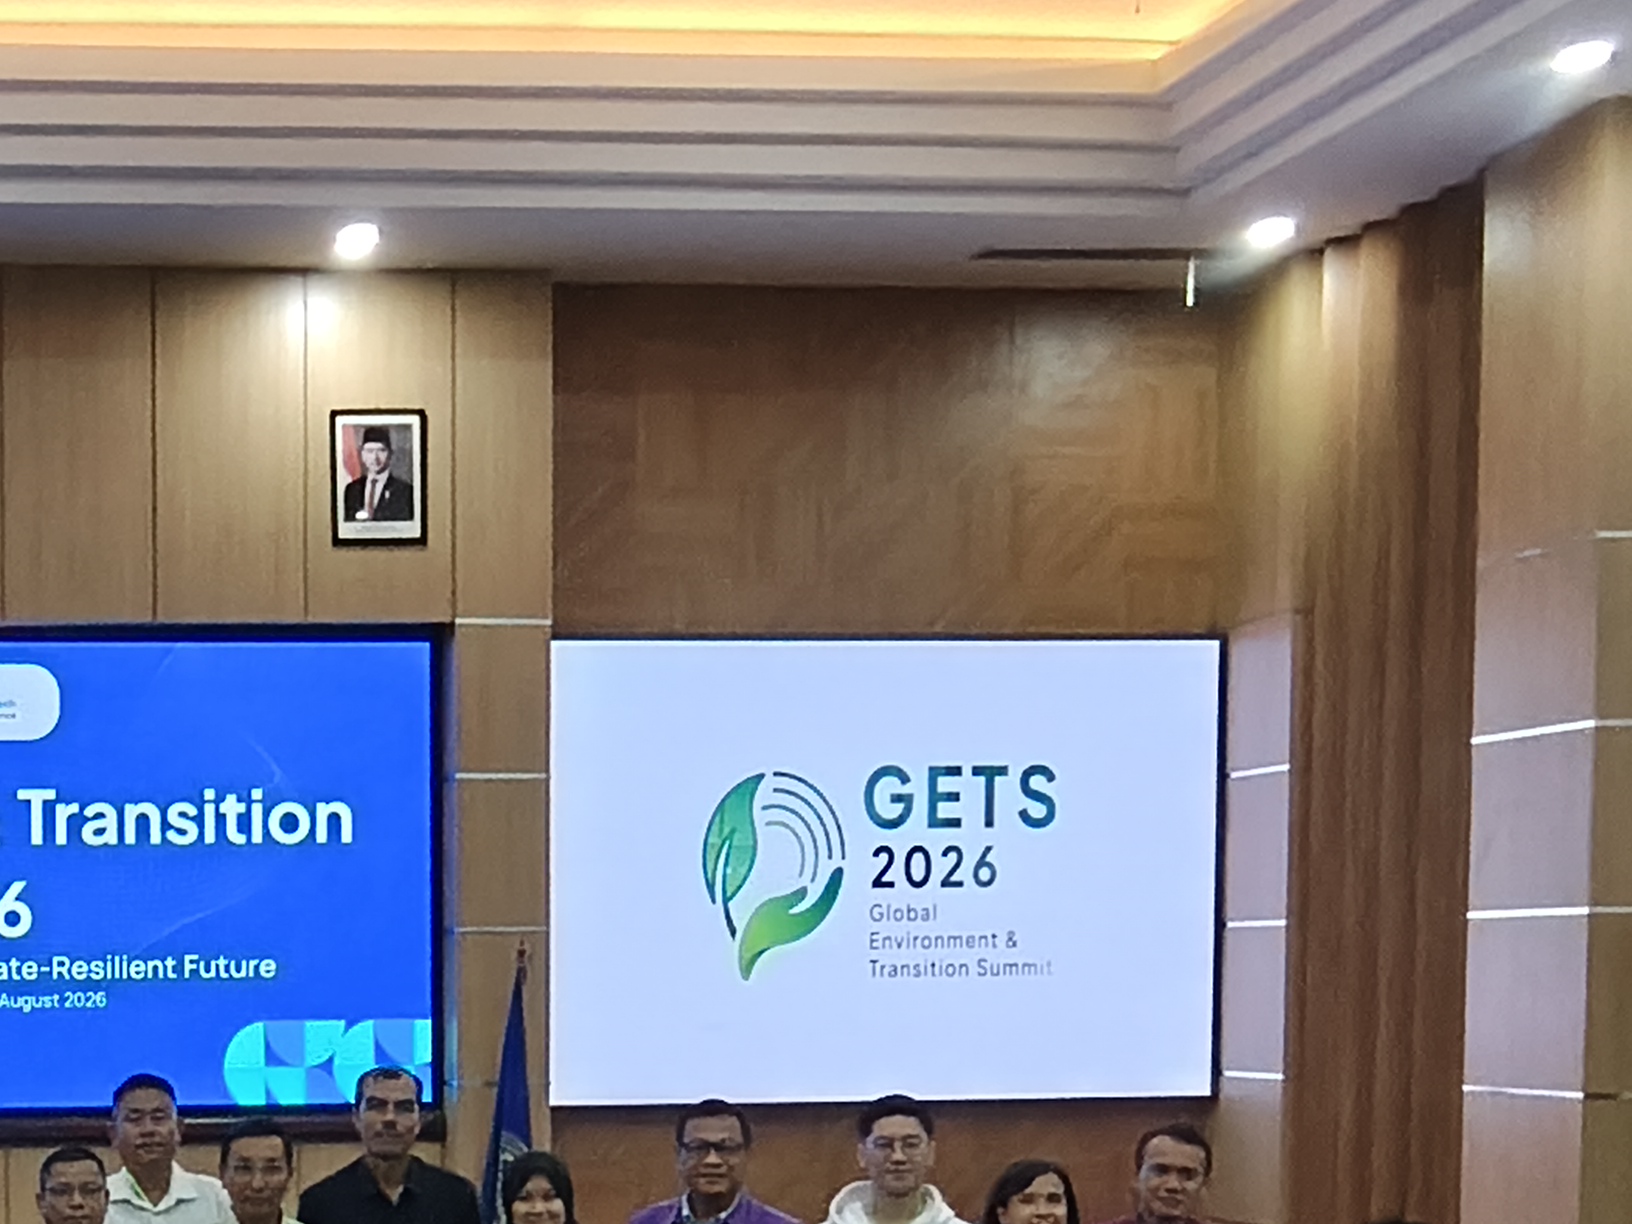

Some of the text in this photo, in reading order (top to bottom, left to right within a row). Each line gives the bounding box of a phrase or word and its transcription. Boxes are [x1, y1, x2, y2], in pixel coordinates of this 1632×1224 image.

[864, 764, 1057, 830] GETS
[17, 787, 353, 848] Transition
[871, 844, 997, 889] 2026
[869, 903, 938, 923] Global
[869, 930, 1019, 951] Environment &
[183, 954, 277, 980] Future
[869, 958, 1054, 979] Transition Summit
[64, 990, 108, 1009] 2026
